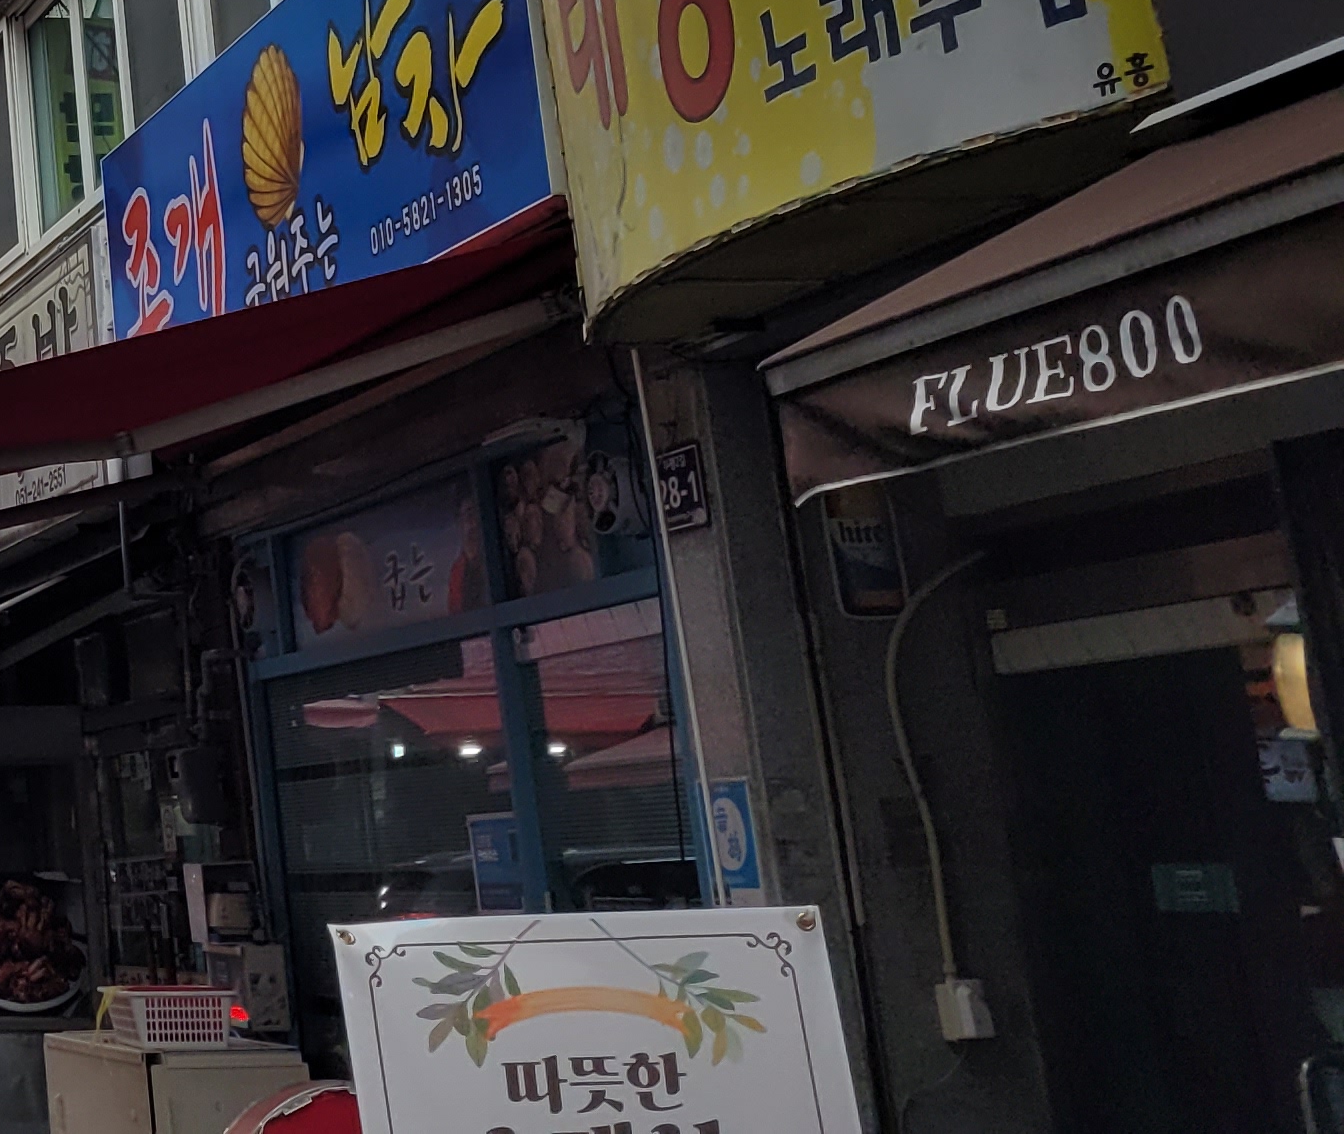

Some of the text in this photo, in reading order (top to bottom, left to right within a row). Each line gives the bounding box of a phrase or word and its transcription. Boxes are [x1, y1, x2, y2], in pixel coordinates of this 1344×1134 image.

[1093, 52, 1154, 96] 유흥
[121, 118, 225, 337] 조개
[246, 198, 340, 309] 구워주는
[370, 164, 483, 256] 010-5821-1305
[910, 295, 1202, 435] FLUE800
[501, 1052, 687, 1114] 따뜻한
